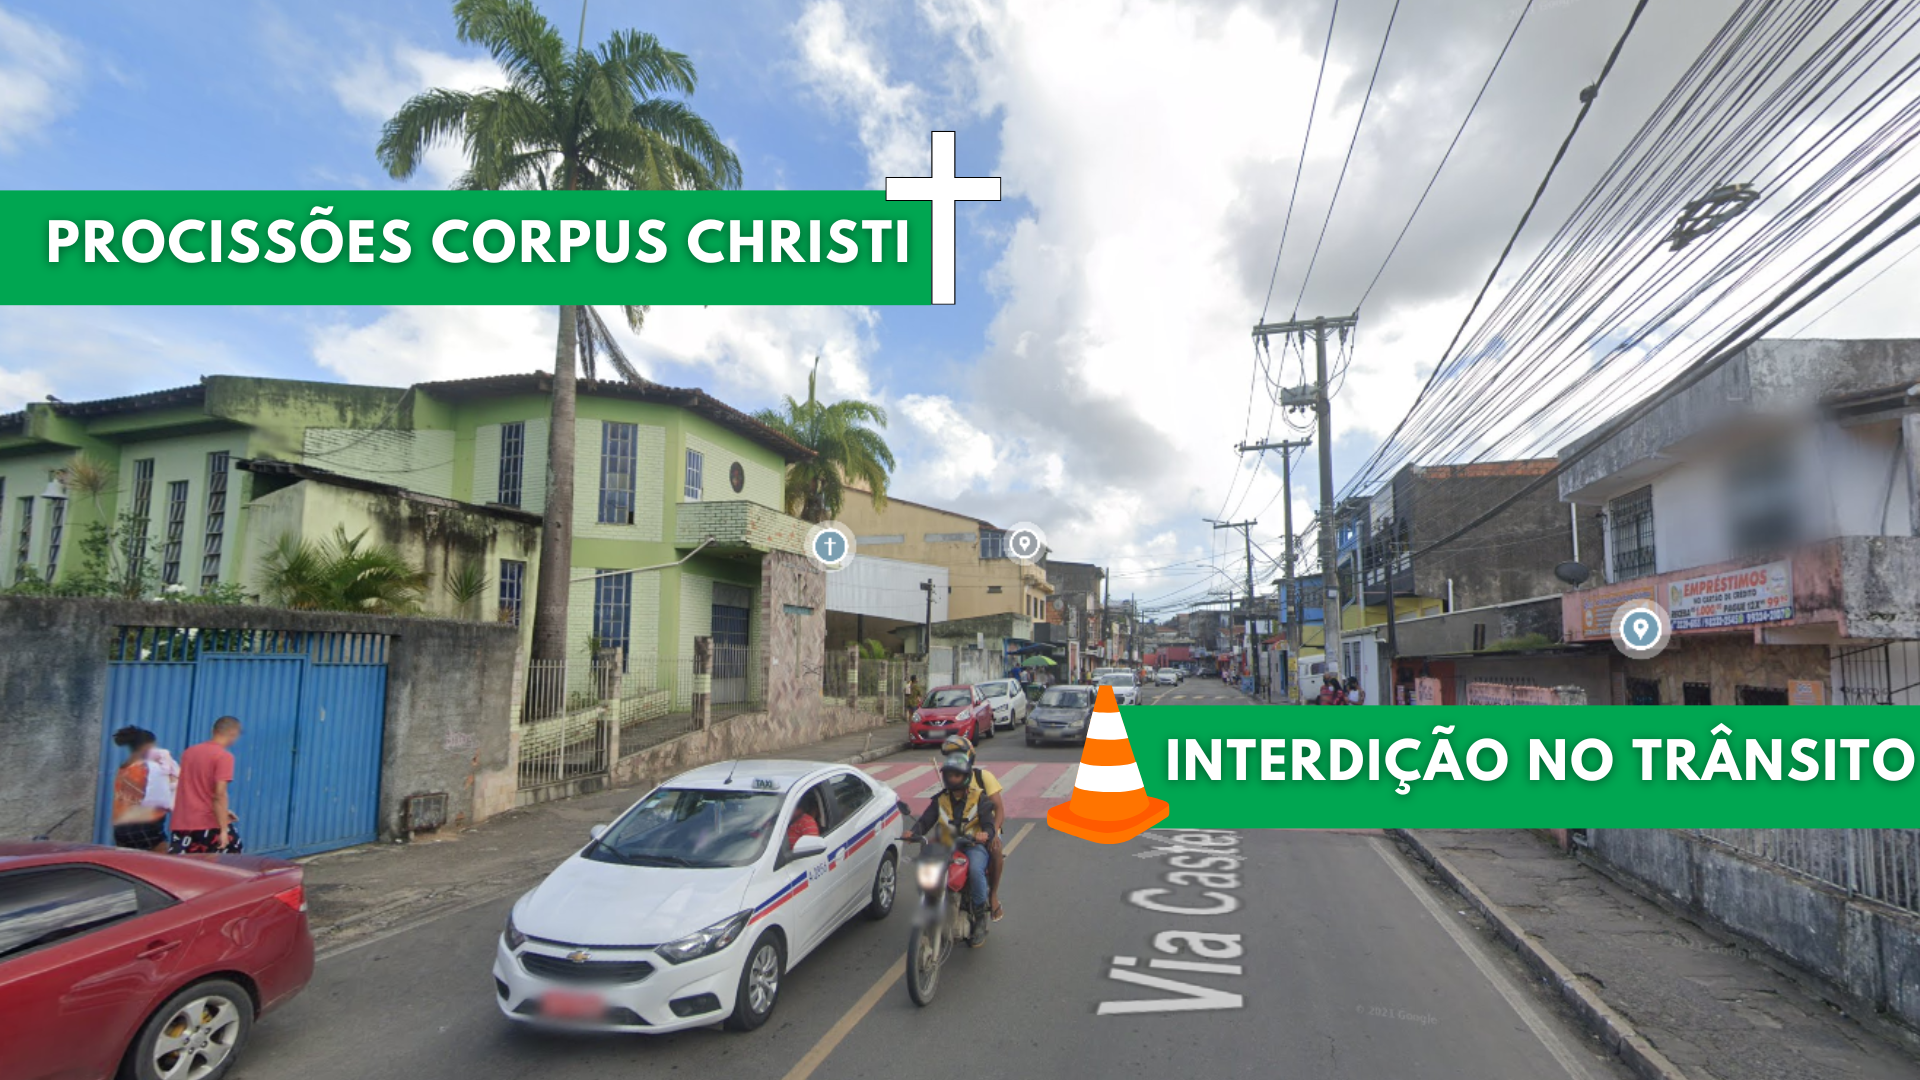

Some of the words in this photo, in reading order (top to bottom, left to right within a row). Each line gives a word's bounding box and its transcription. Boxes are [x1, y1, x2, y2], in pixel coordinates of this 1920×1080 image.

[1684, 569, 1767, 597] EMPRÉSTIMOS
[1724, 592, 1732, 601] DE
[756, 778, 773, 788] TAXI
